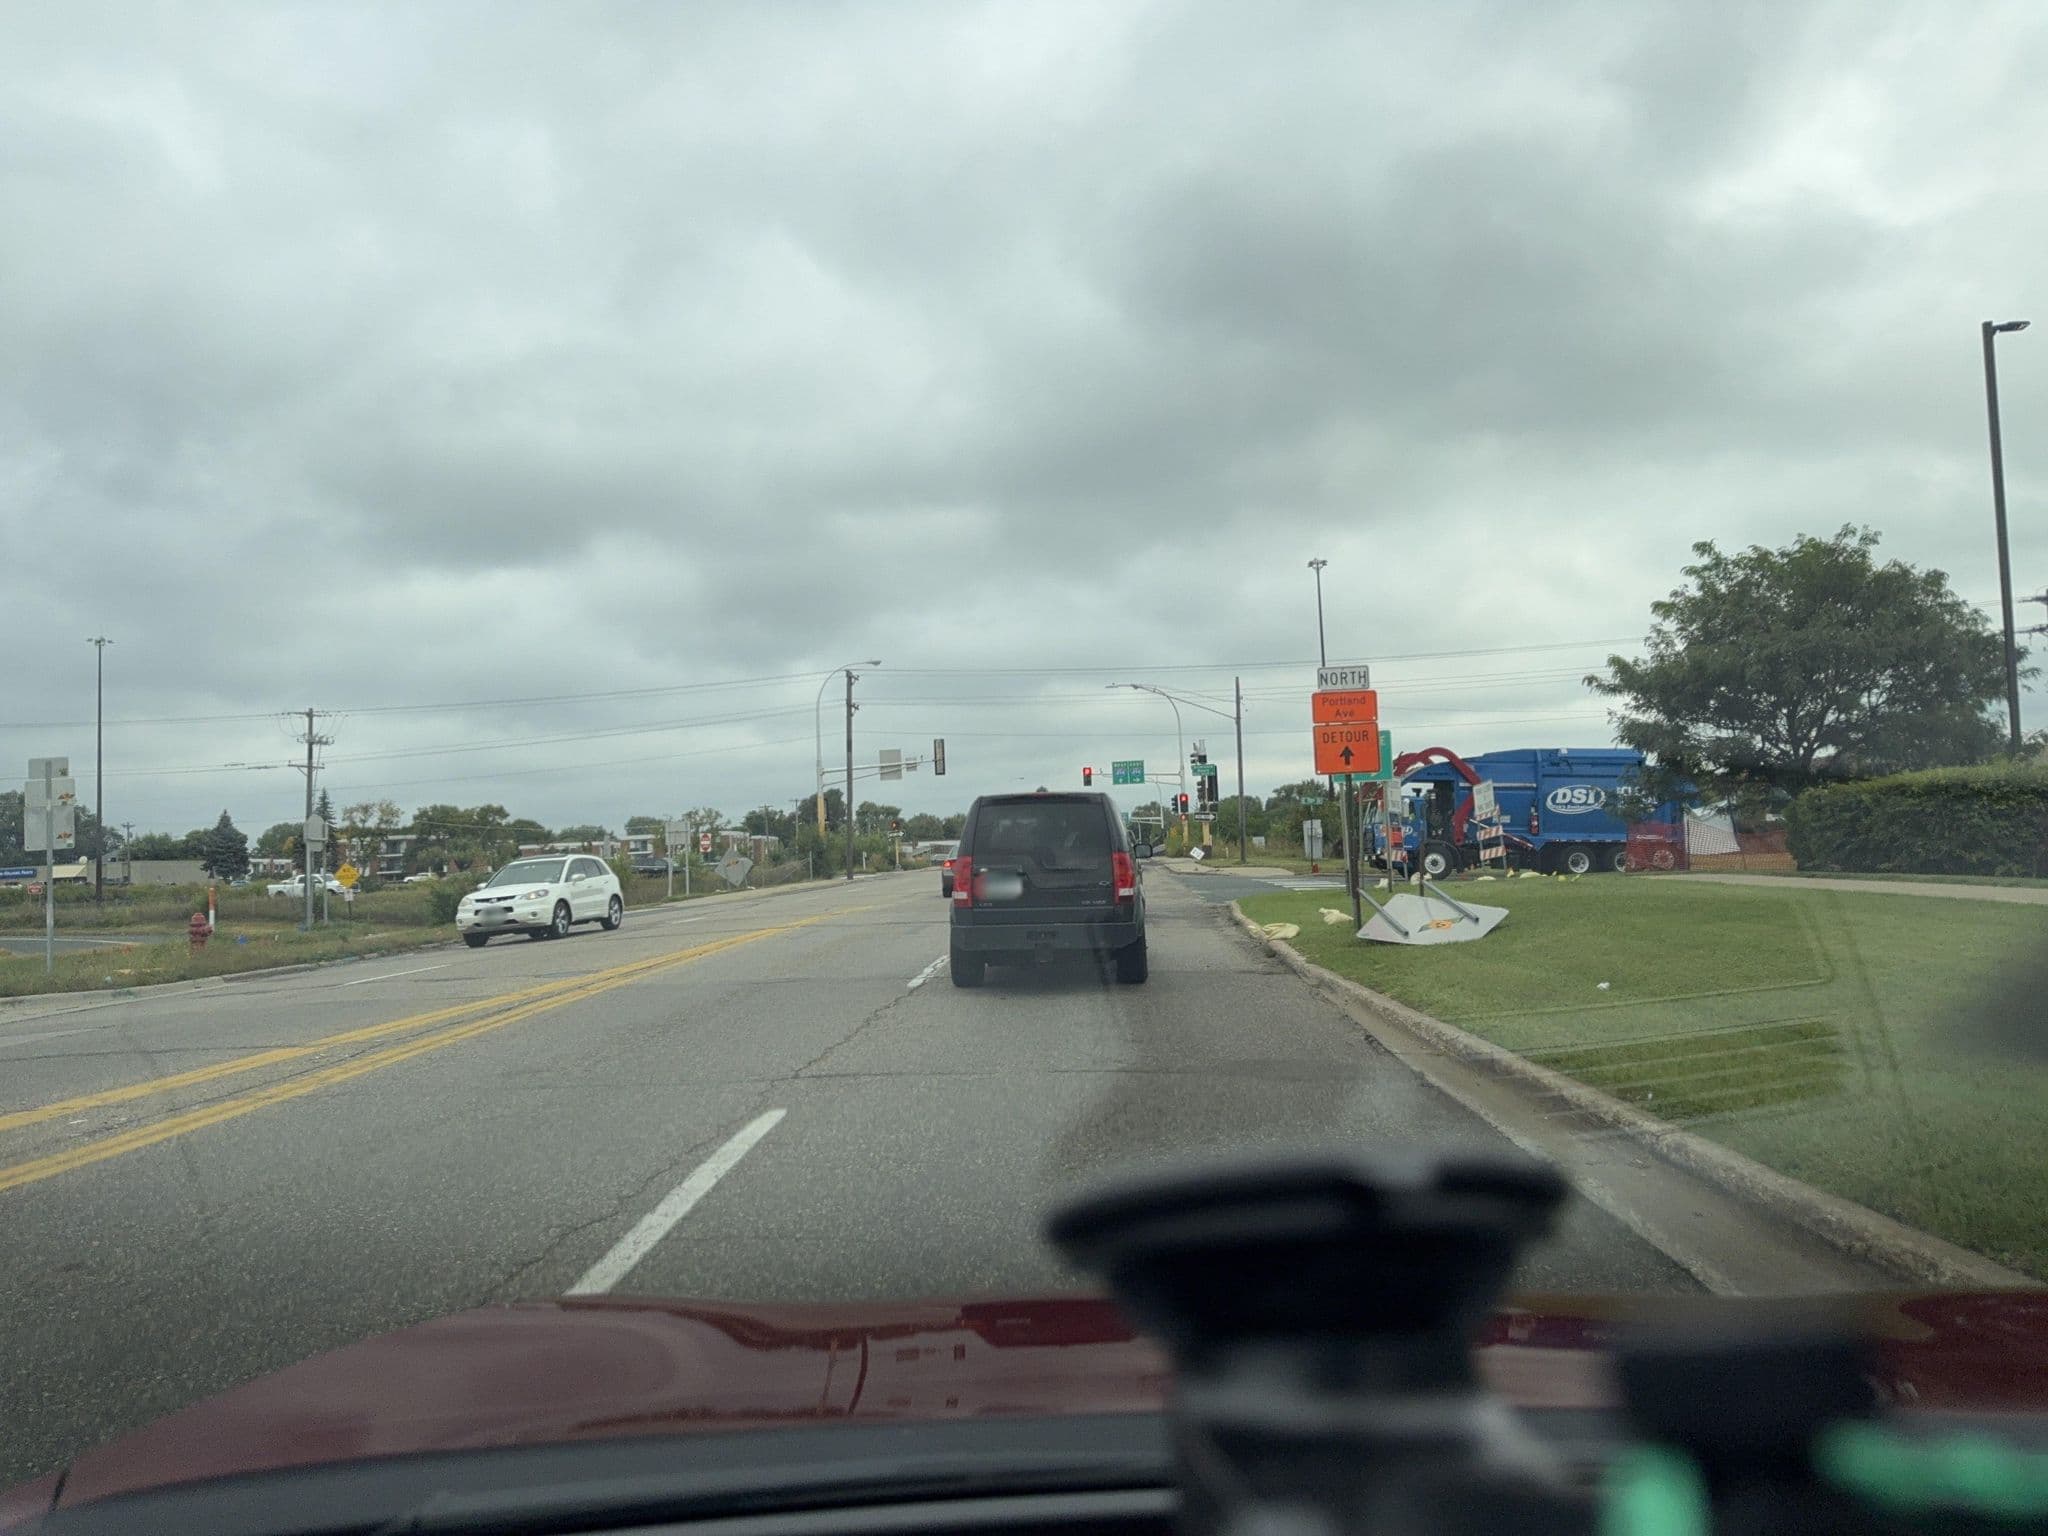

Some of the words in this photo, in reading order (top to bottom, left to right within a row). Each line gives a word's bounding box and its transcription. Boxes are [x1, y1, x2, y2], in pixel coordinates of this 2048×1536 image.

[1320, 671, 1367, 686] NORTH
[1322, 695, 1366, 706] Portland
[1335, 709, 1355, 718] Ave
[1322, 730, 1369, 744] DETOUR
[1556, 788, 1596, 804] DSI
